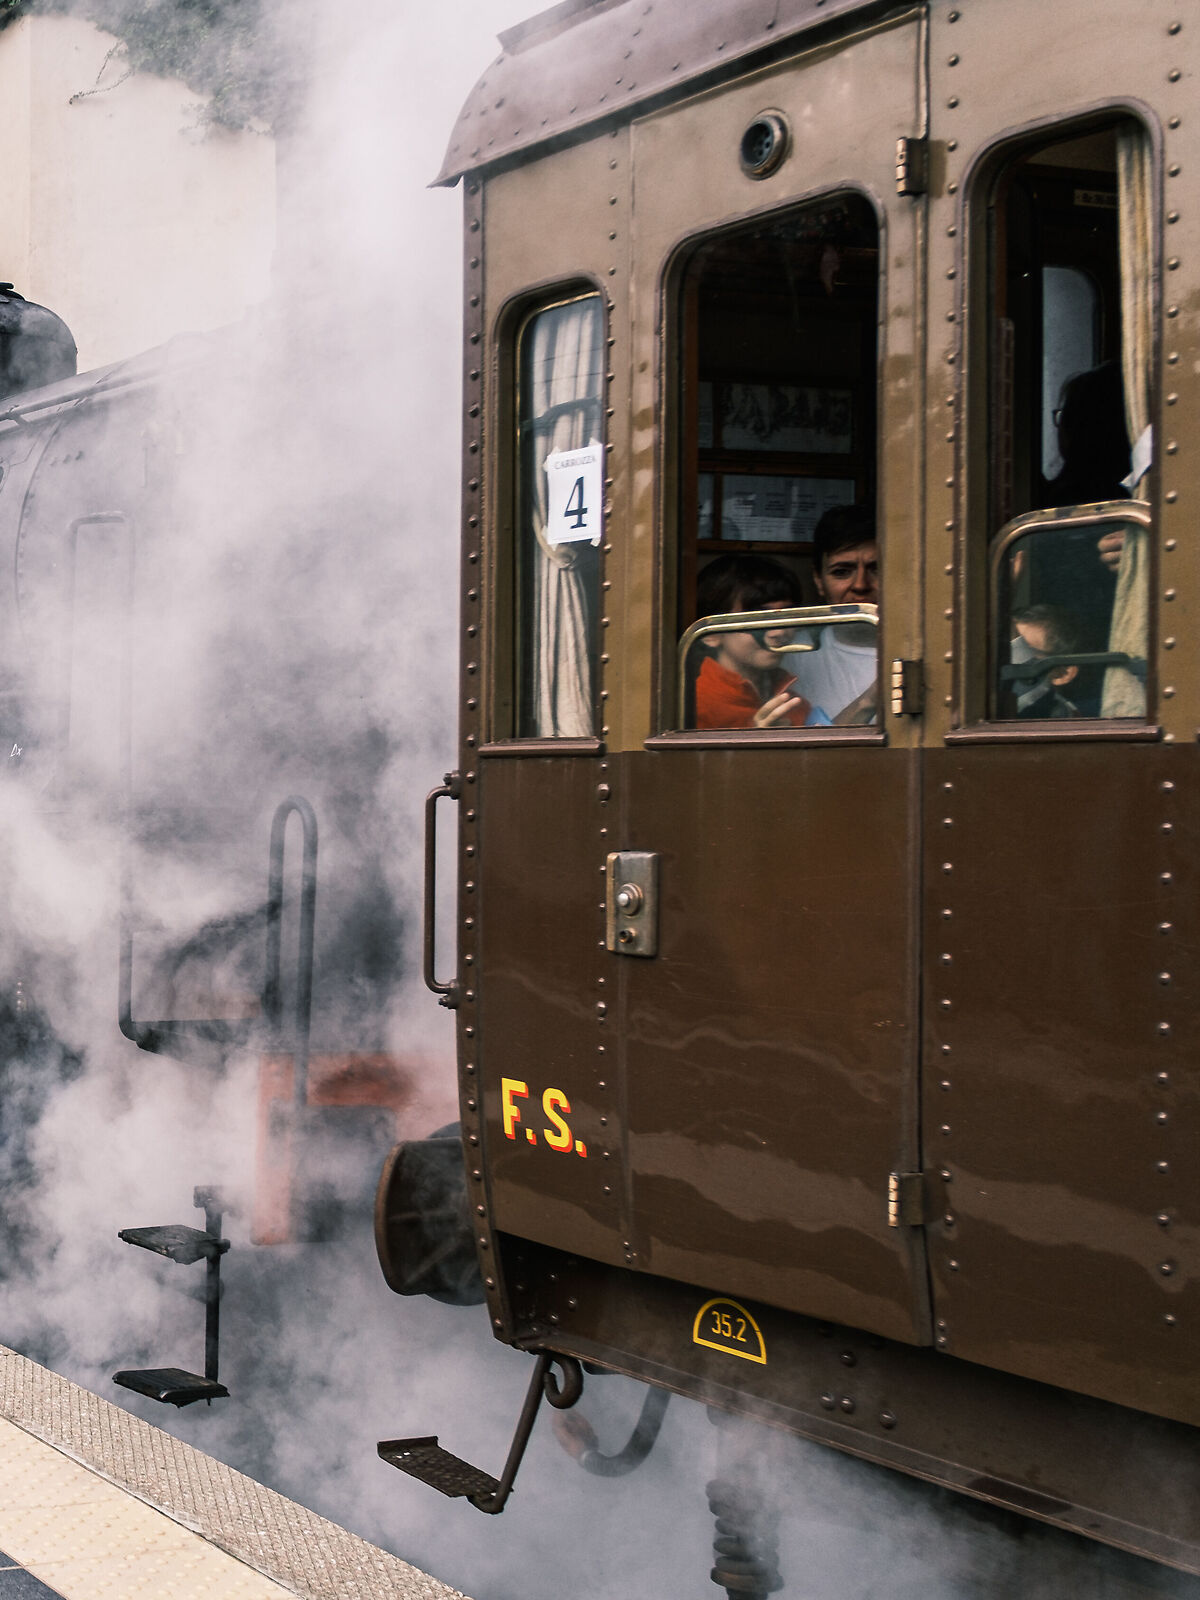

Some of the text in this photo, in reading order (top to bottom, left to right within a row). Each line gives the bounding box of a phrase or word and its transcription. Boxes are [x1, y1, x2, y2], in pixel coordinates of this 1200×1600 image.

[554, 455, 596, 470] CARROZZA
[564, 476, 588, 530] 4
[501, 1077, 587, 1158] F.S.
[711, 1310, 747, 1342] 35.2
